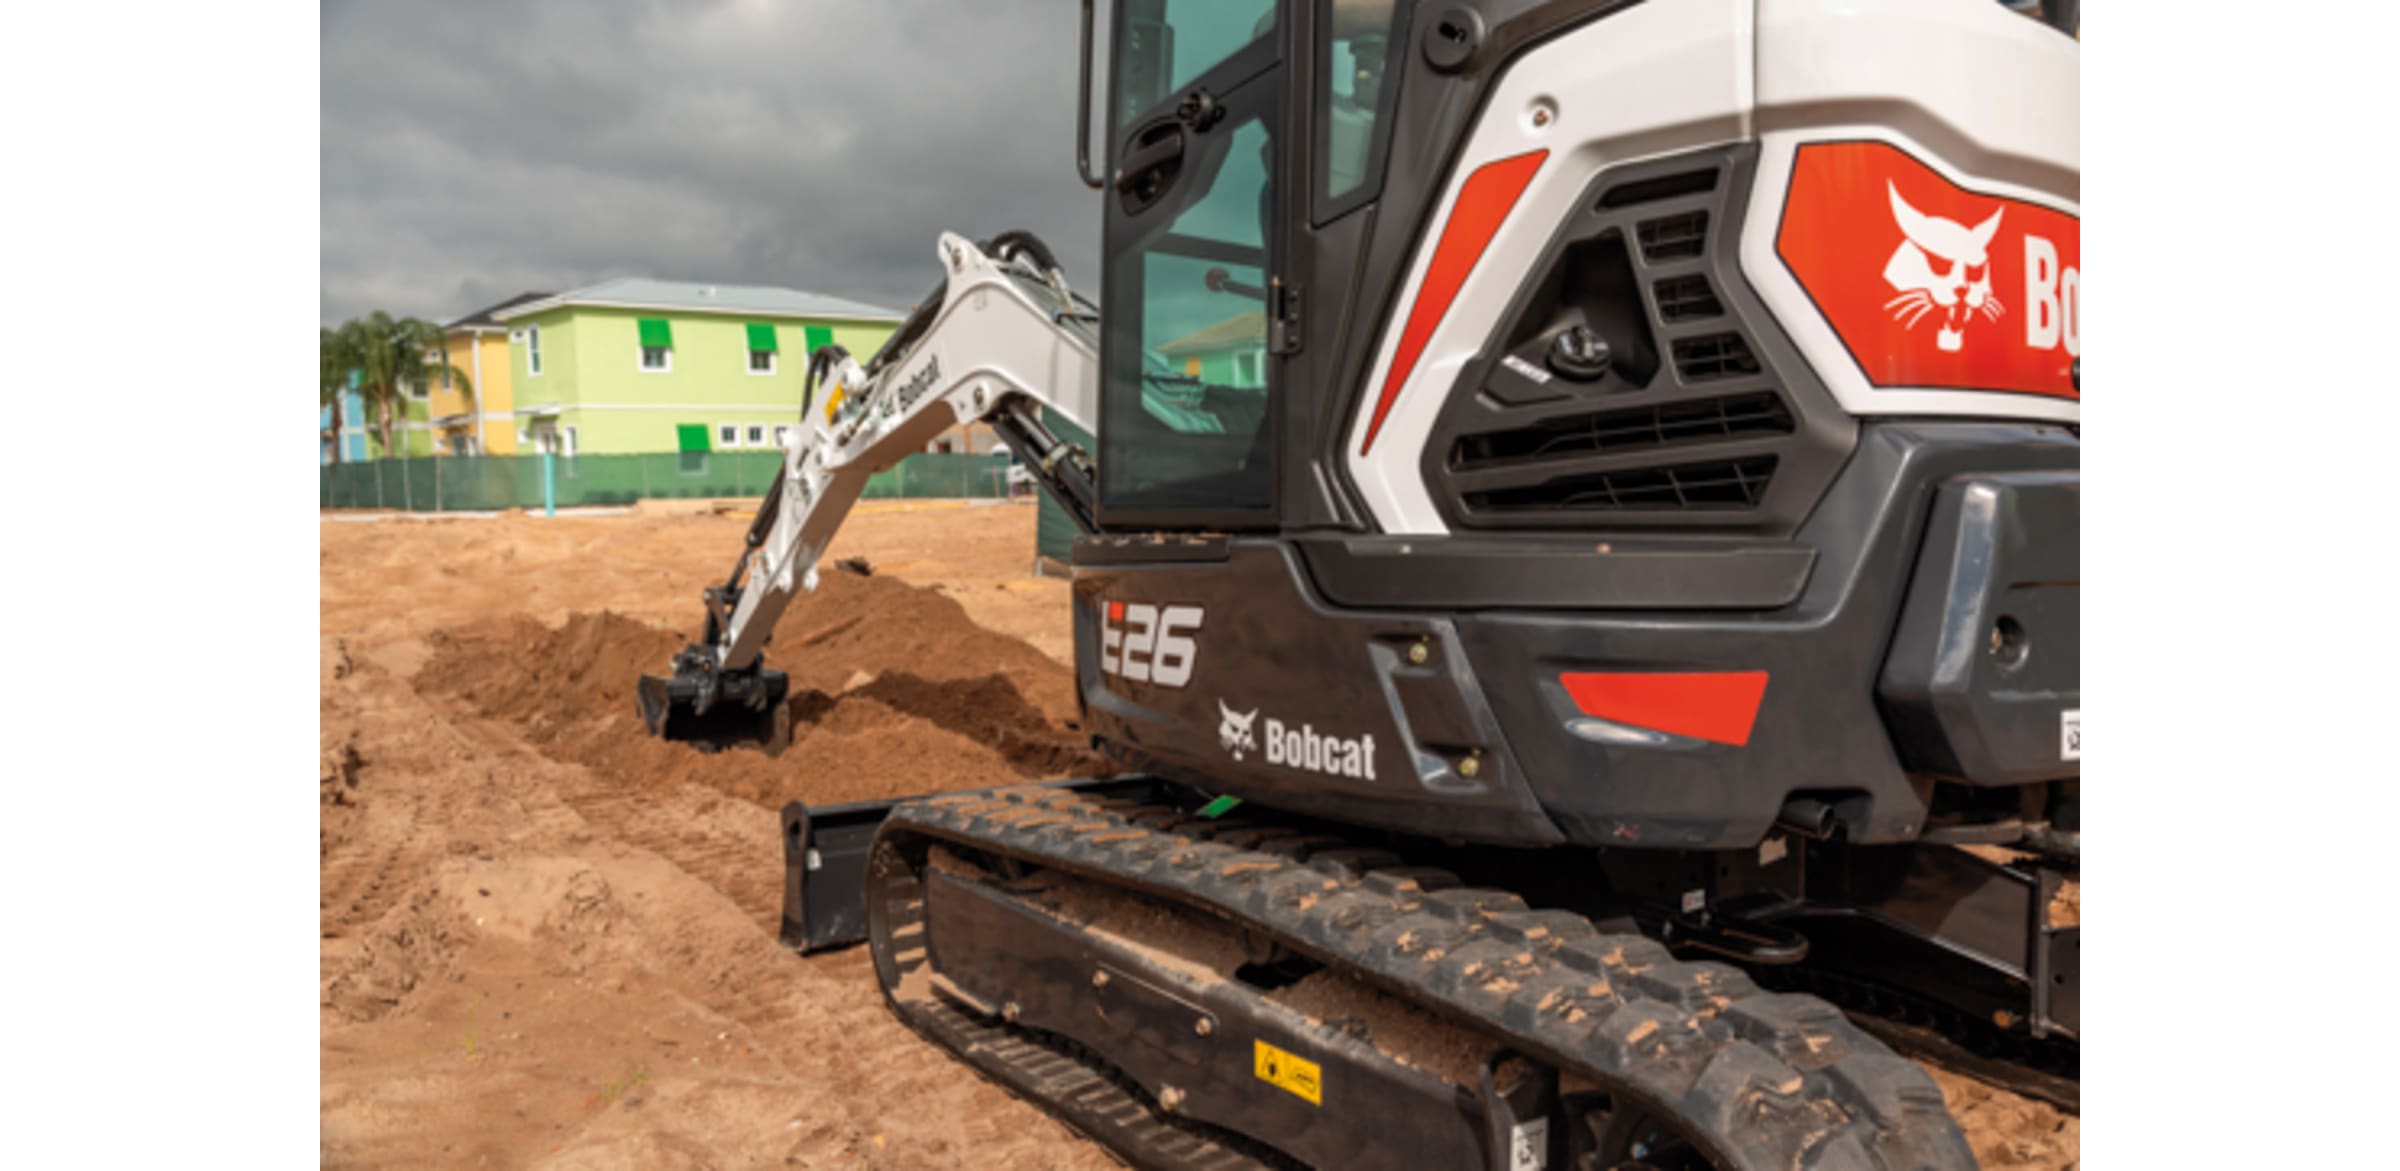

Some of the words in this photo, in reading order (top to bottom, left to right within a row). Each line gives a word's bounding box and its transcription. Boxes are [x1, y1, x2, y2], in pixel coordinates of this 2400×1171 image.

[899, 352, 941, 412] Bobcat
[1101, 601, 1204, 687] E26
[1264, 718, 1376, 780] Bobcat
